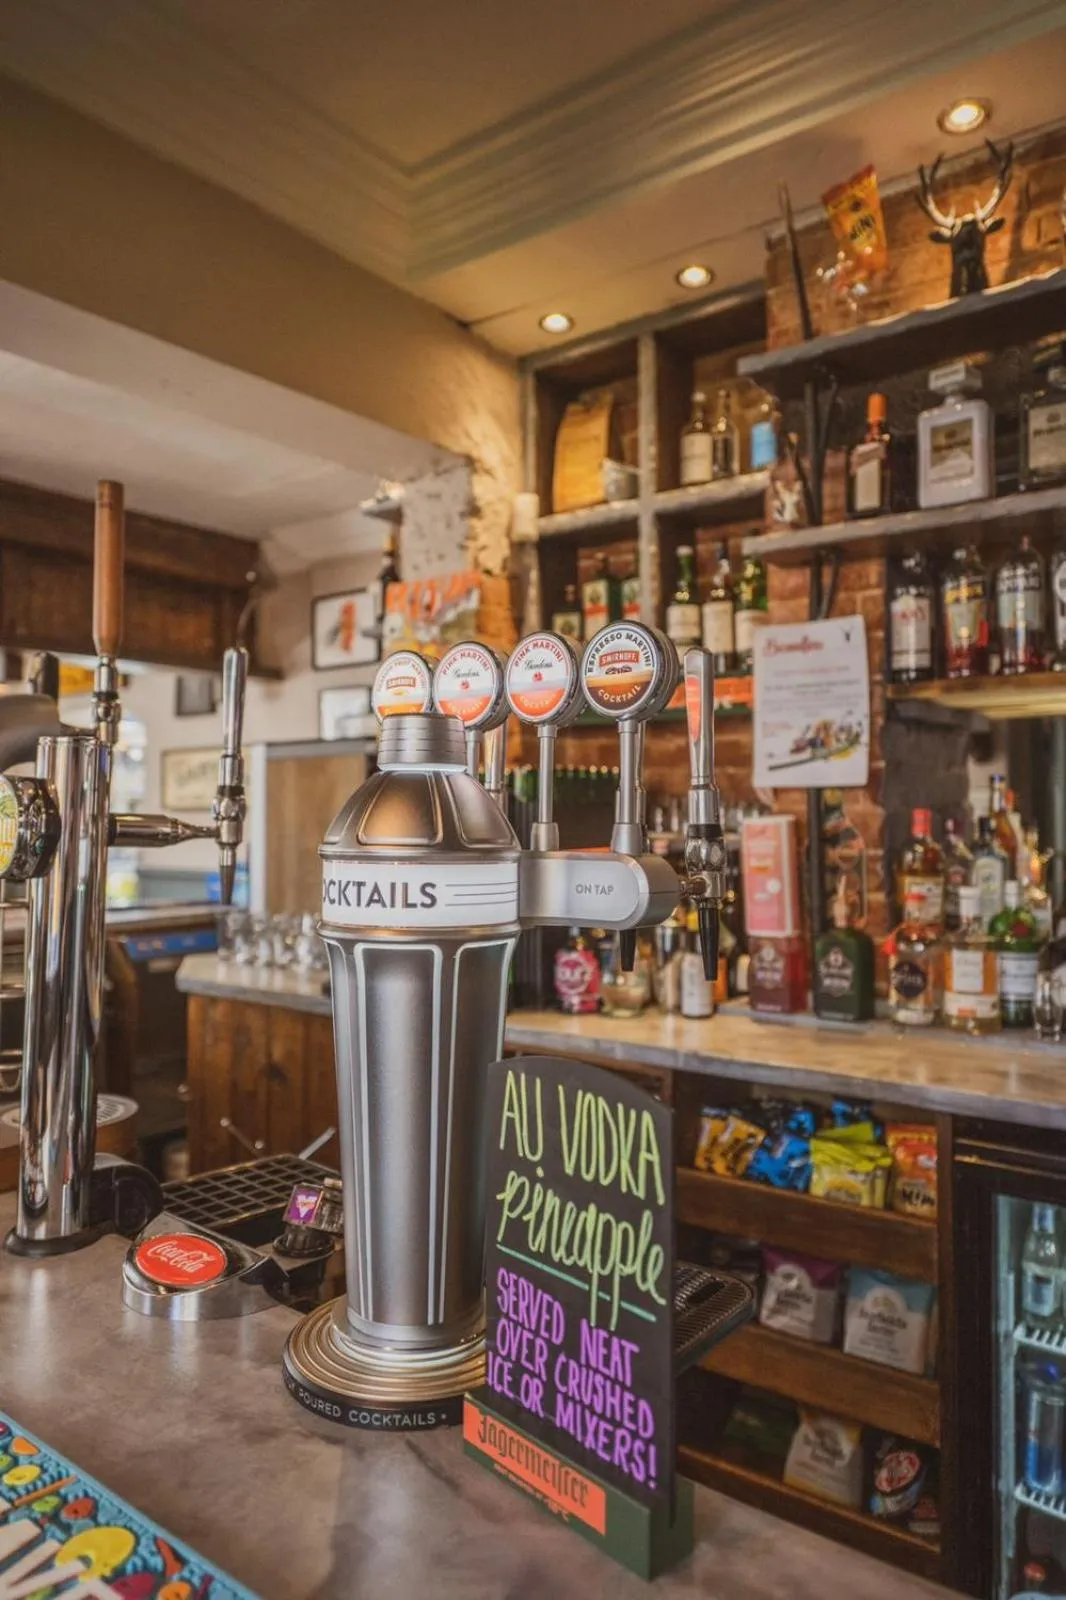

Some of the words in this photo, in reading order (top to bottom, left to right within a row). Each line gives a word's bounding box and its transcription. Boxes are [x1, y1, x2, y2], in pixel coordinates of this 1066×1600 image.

[514, 646, 531, 667] PINK
[533, 641, 564, 662] MARTINI
[587, 632, 622, 673] ESPRESSO
[625, 632, 651, 667] MARTINI
[597, 685, 641, 703] COCKTAIL
[575, 883, 592, 895] ON
[594, 884, 614, 896] TAP
[499, 1069, 543, 1162] AU
[558, 1084, 665, 1206] VODKA
[496, 1166, 667, 1331] pineapple
[496, 1267, 565, 1345] SERVED
[580, 1318, 640, 1388] NEAT
[299, 1388, 342, 1417] POURED
[349, 1410, 436, 1427] COCKTAILS
[496, 1318, 548, 1382] OVER
[554, 1351, 654, 1438] CRUSHED
[487, 1350, 515, 1398] ICE
[520, 1373, 545, 1418] OR
[555, 1392, 657, 1490] MIXERS!
